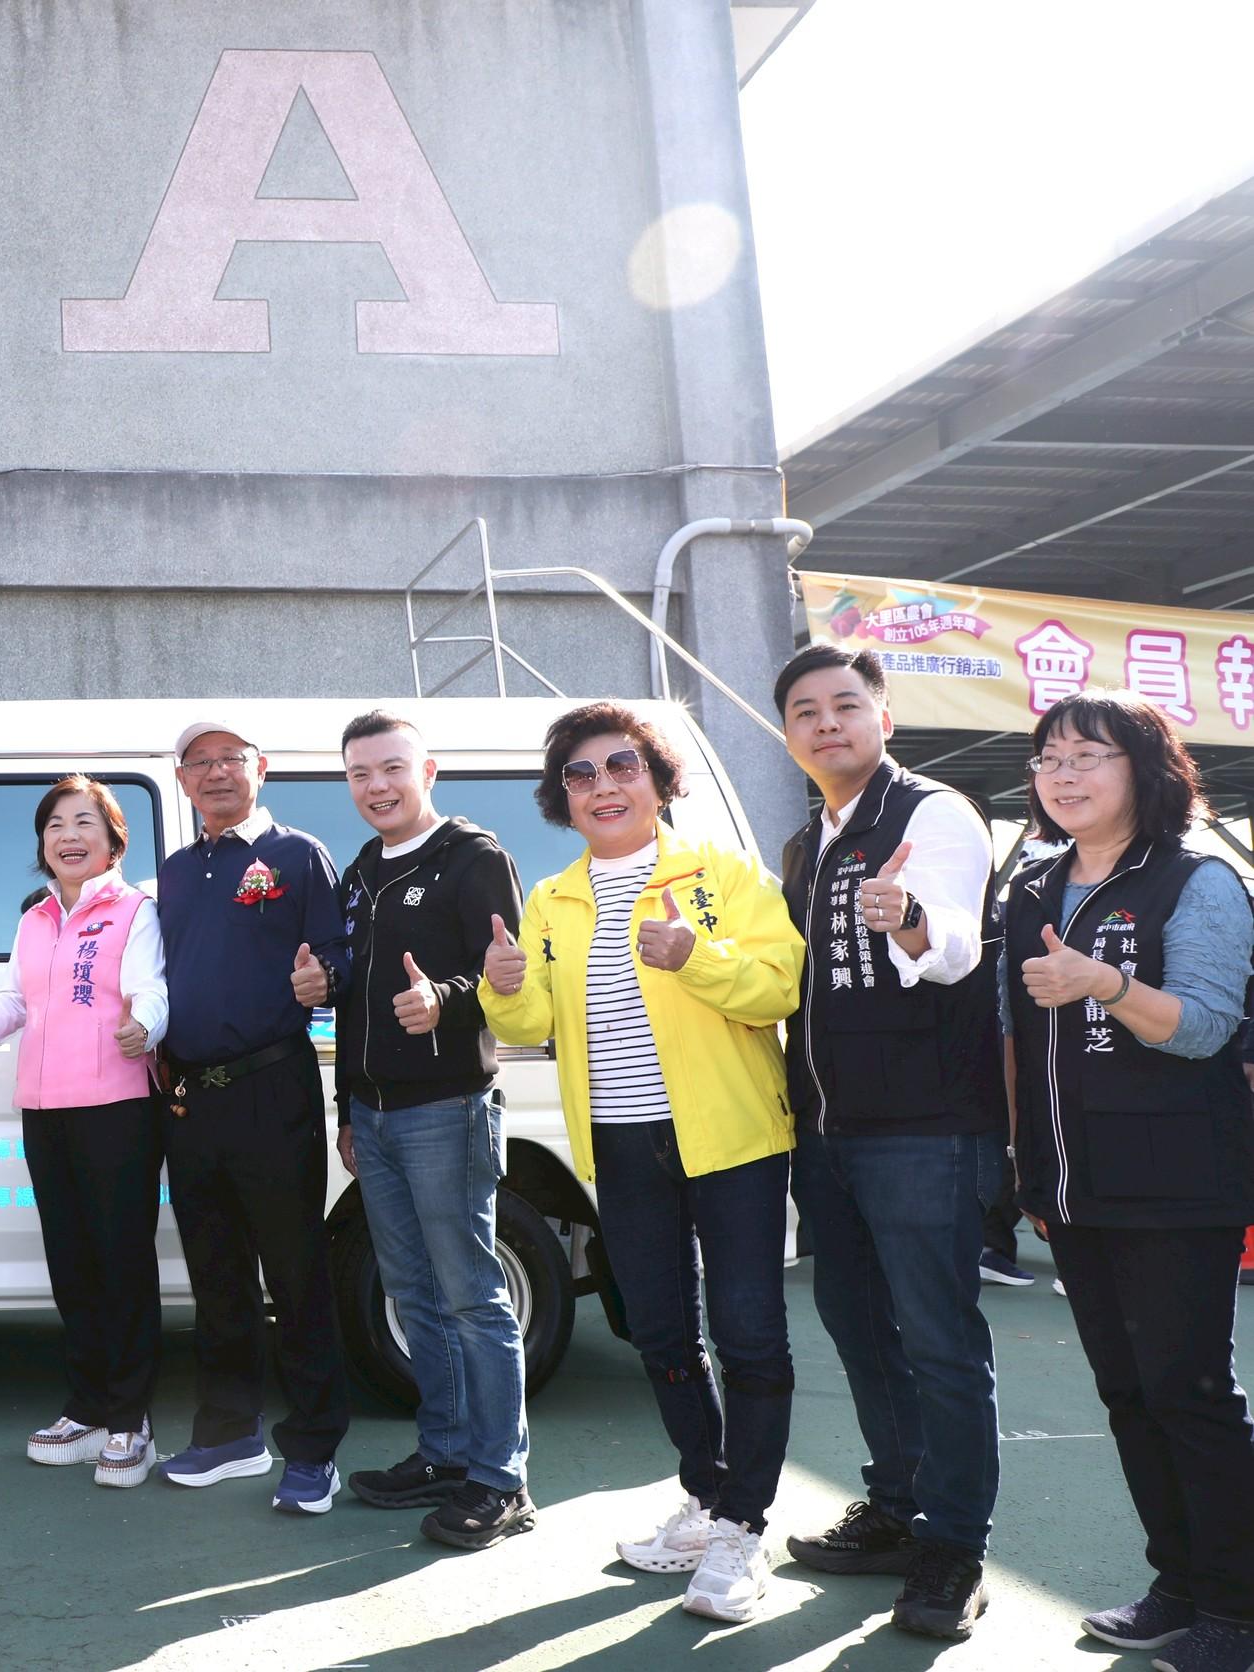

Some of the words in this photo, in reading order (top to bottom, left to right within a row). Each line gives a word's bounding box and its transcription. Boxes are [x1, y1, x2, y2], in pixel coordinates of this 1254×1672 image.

[61, 49, 561, 355] A
[864, 602, 933, 629] 大里區農會
[874, 652, 1002, 677] 產品推廣行銷活動
[72, 940, 98, 1007] 楊瓊瓔
[830, 911, 853, 991] 林家興
